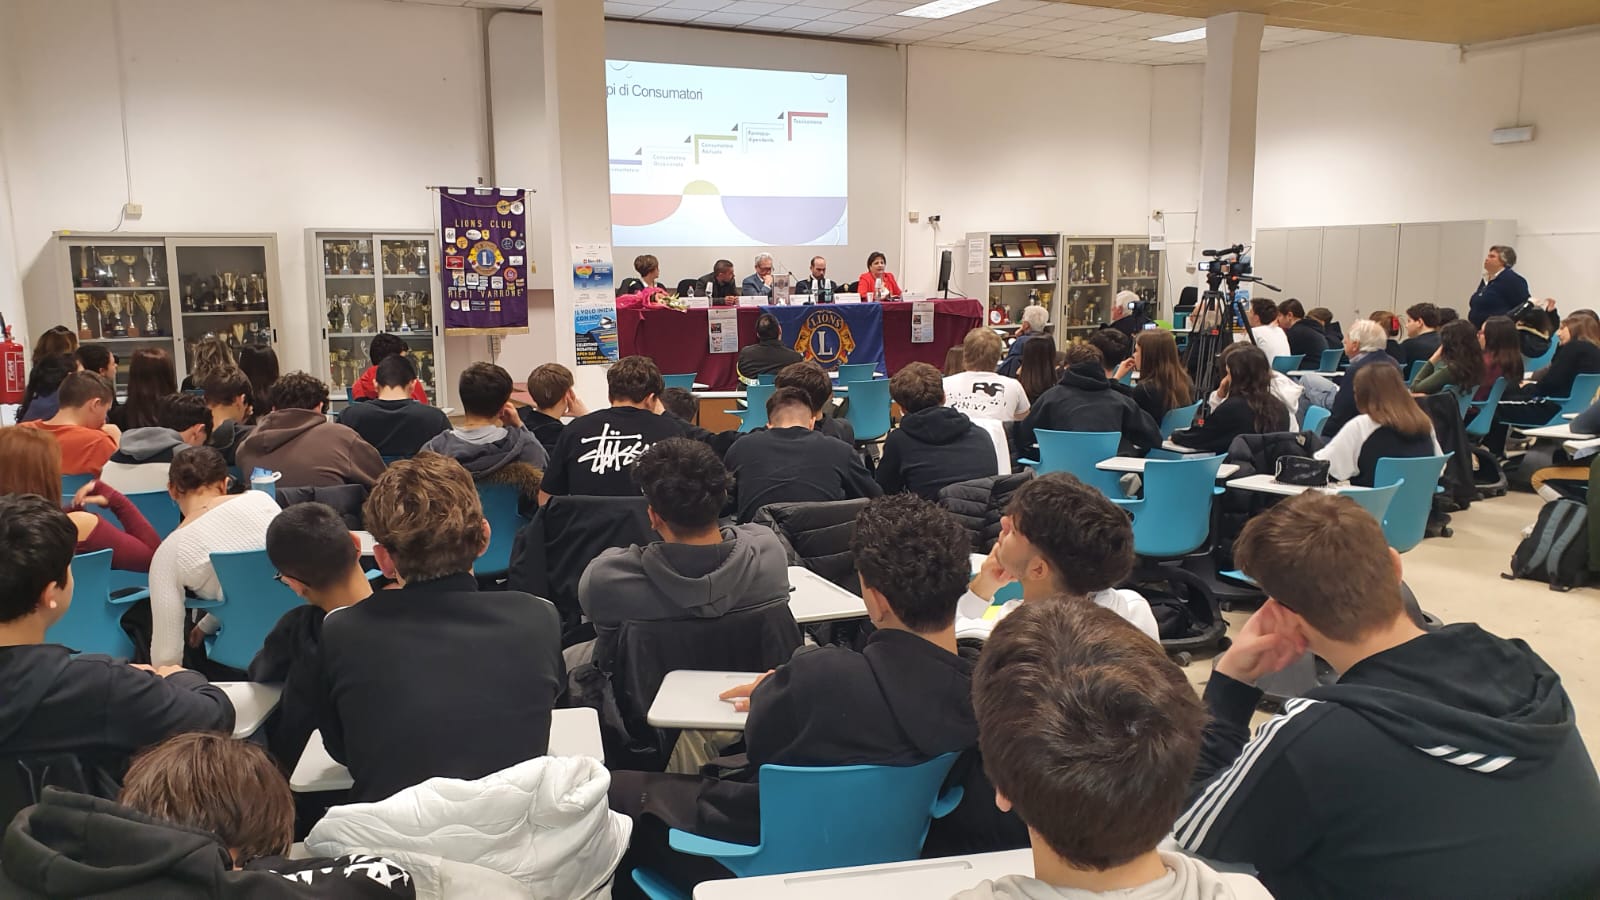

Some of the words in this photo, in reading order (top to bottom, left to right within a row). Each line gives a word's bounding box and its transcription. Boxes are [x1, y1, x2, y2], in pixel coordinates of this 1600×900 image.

[619, 83, 629, 96] di
[632, 84, 703, 100] Consumatori
[455, 219, 483, 228] LIONS
[490, 219, 513, 229] CLUB
[482, 251, 492, 265] L
[811, 313, 841, 329] LIONS
[817, 331, 833, 356] L
